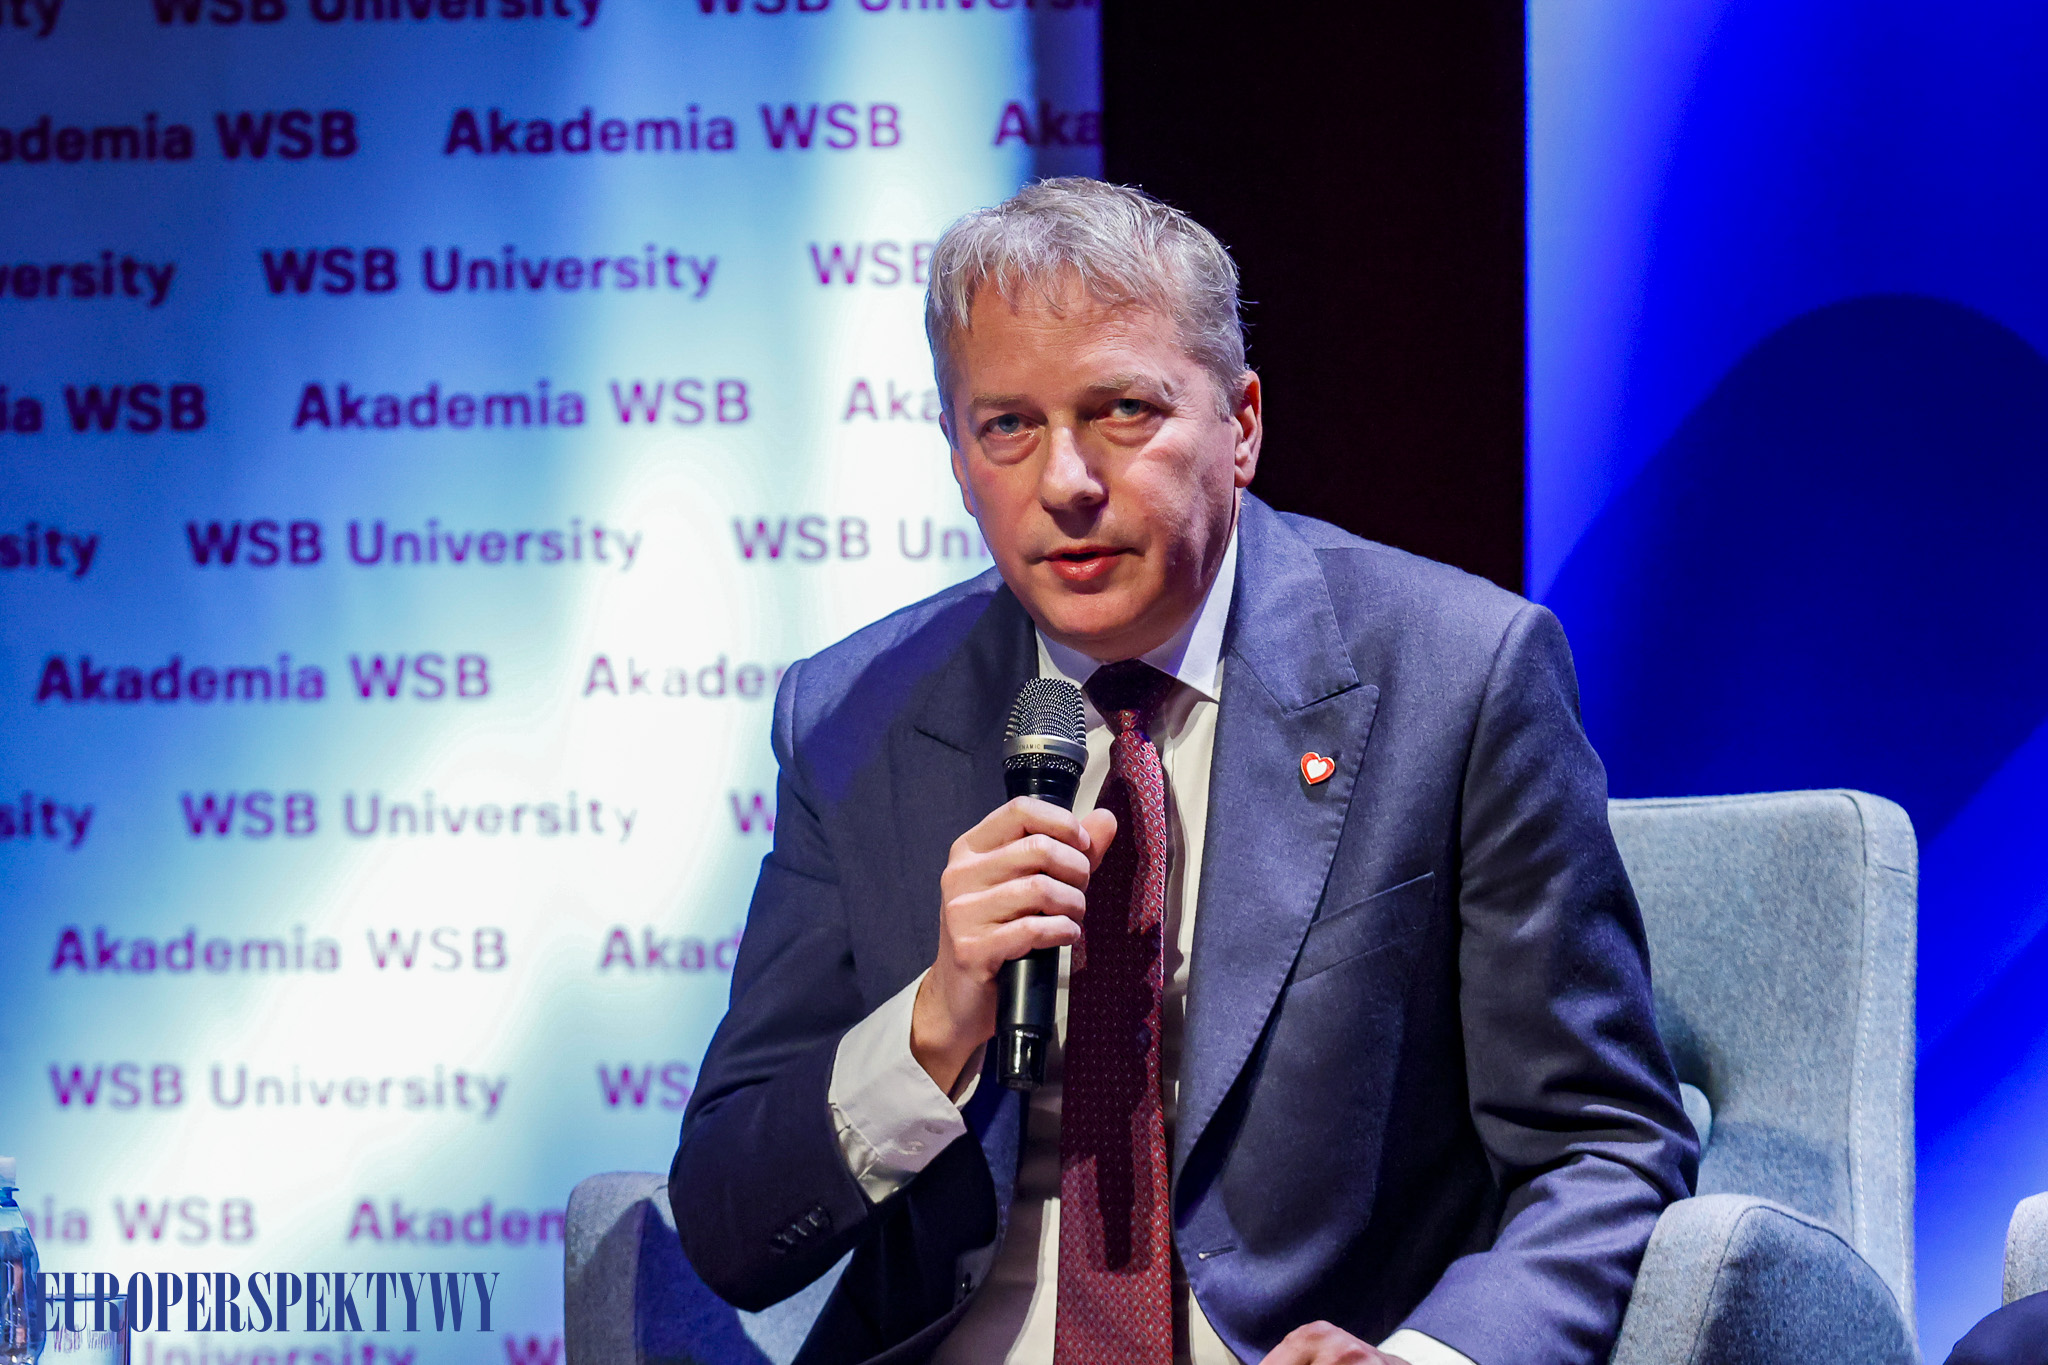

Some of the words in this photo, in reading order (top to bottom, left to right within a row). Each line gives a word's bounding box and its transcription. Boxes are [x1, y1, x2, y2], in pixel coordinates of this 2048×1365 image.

[0, 0, 63, 38] ty
[213, 110, 360, 160] WSB
[443, 105, 736, 155] Akademia
[758, 103, 901, 151] WSB
[261, 246, 400, 295] WSB
[421, 244, 718, 299] University
[63, 383, 207, 433] WSB
[292, 380, 586, 431] Akademia
[609, 378, 751, 426] WSB
[185, 519, 323, 567] WSB
[346, 519, 641, 570] University
[733, 515, 869, 562] WSB
[36, 655, 325, 703] Akademia
[348, 653, 490, 700] WSB
[583, 653, 785, 702] Akade
[180, 790, 317, 838] WSB
[344, 789, 637, 842] University
[50, 924, 341, 974] Akademia
[366, 926, 508, 972] WSB
[48, 1063, 184, 1109] WSB
[209, 1063, 509, 1120] University
[23, 1196, 90, 1241] ia
[113, 1197, 257, 1244] WSB
